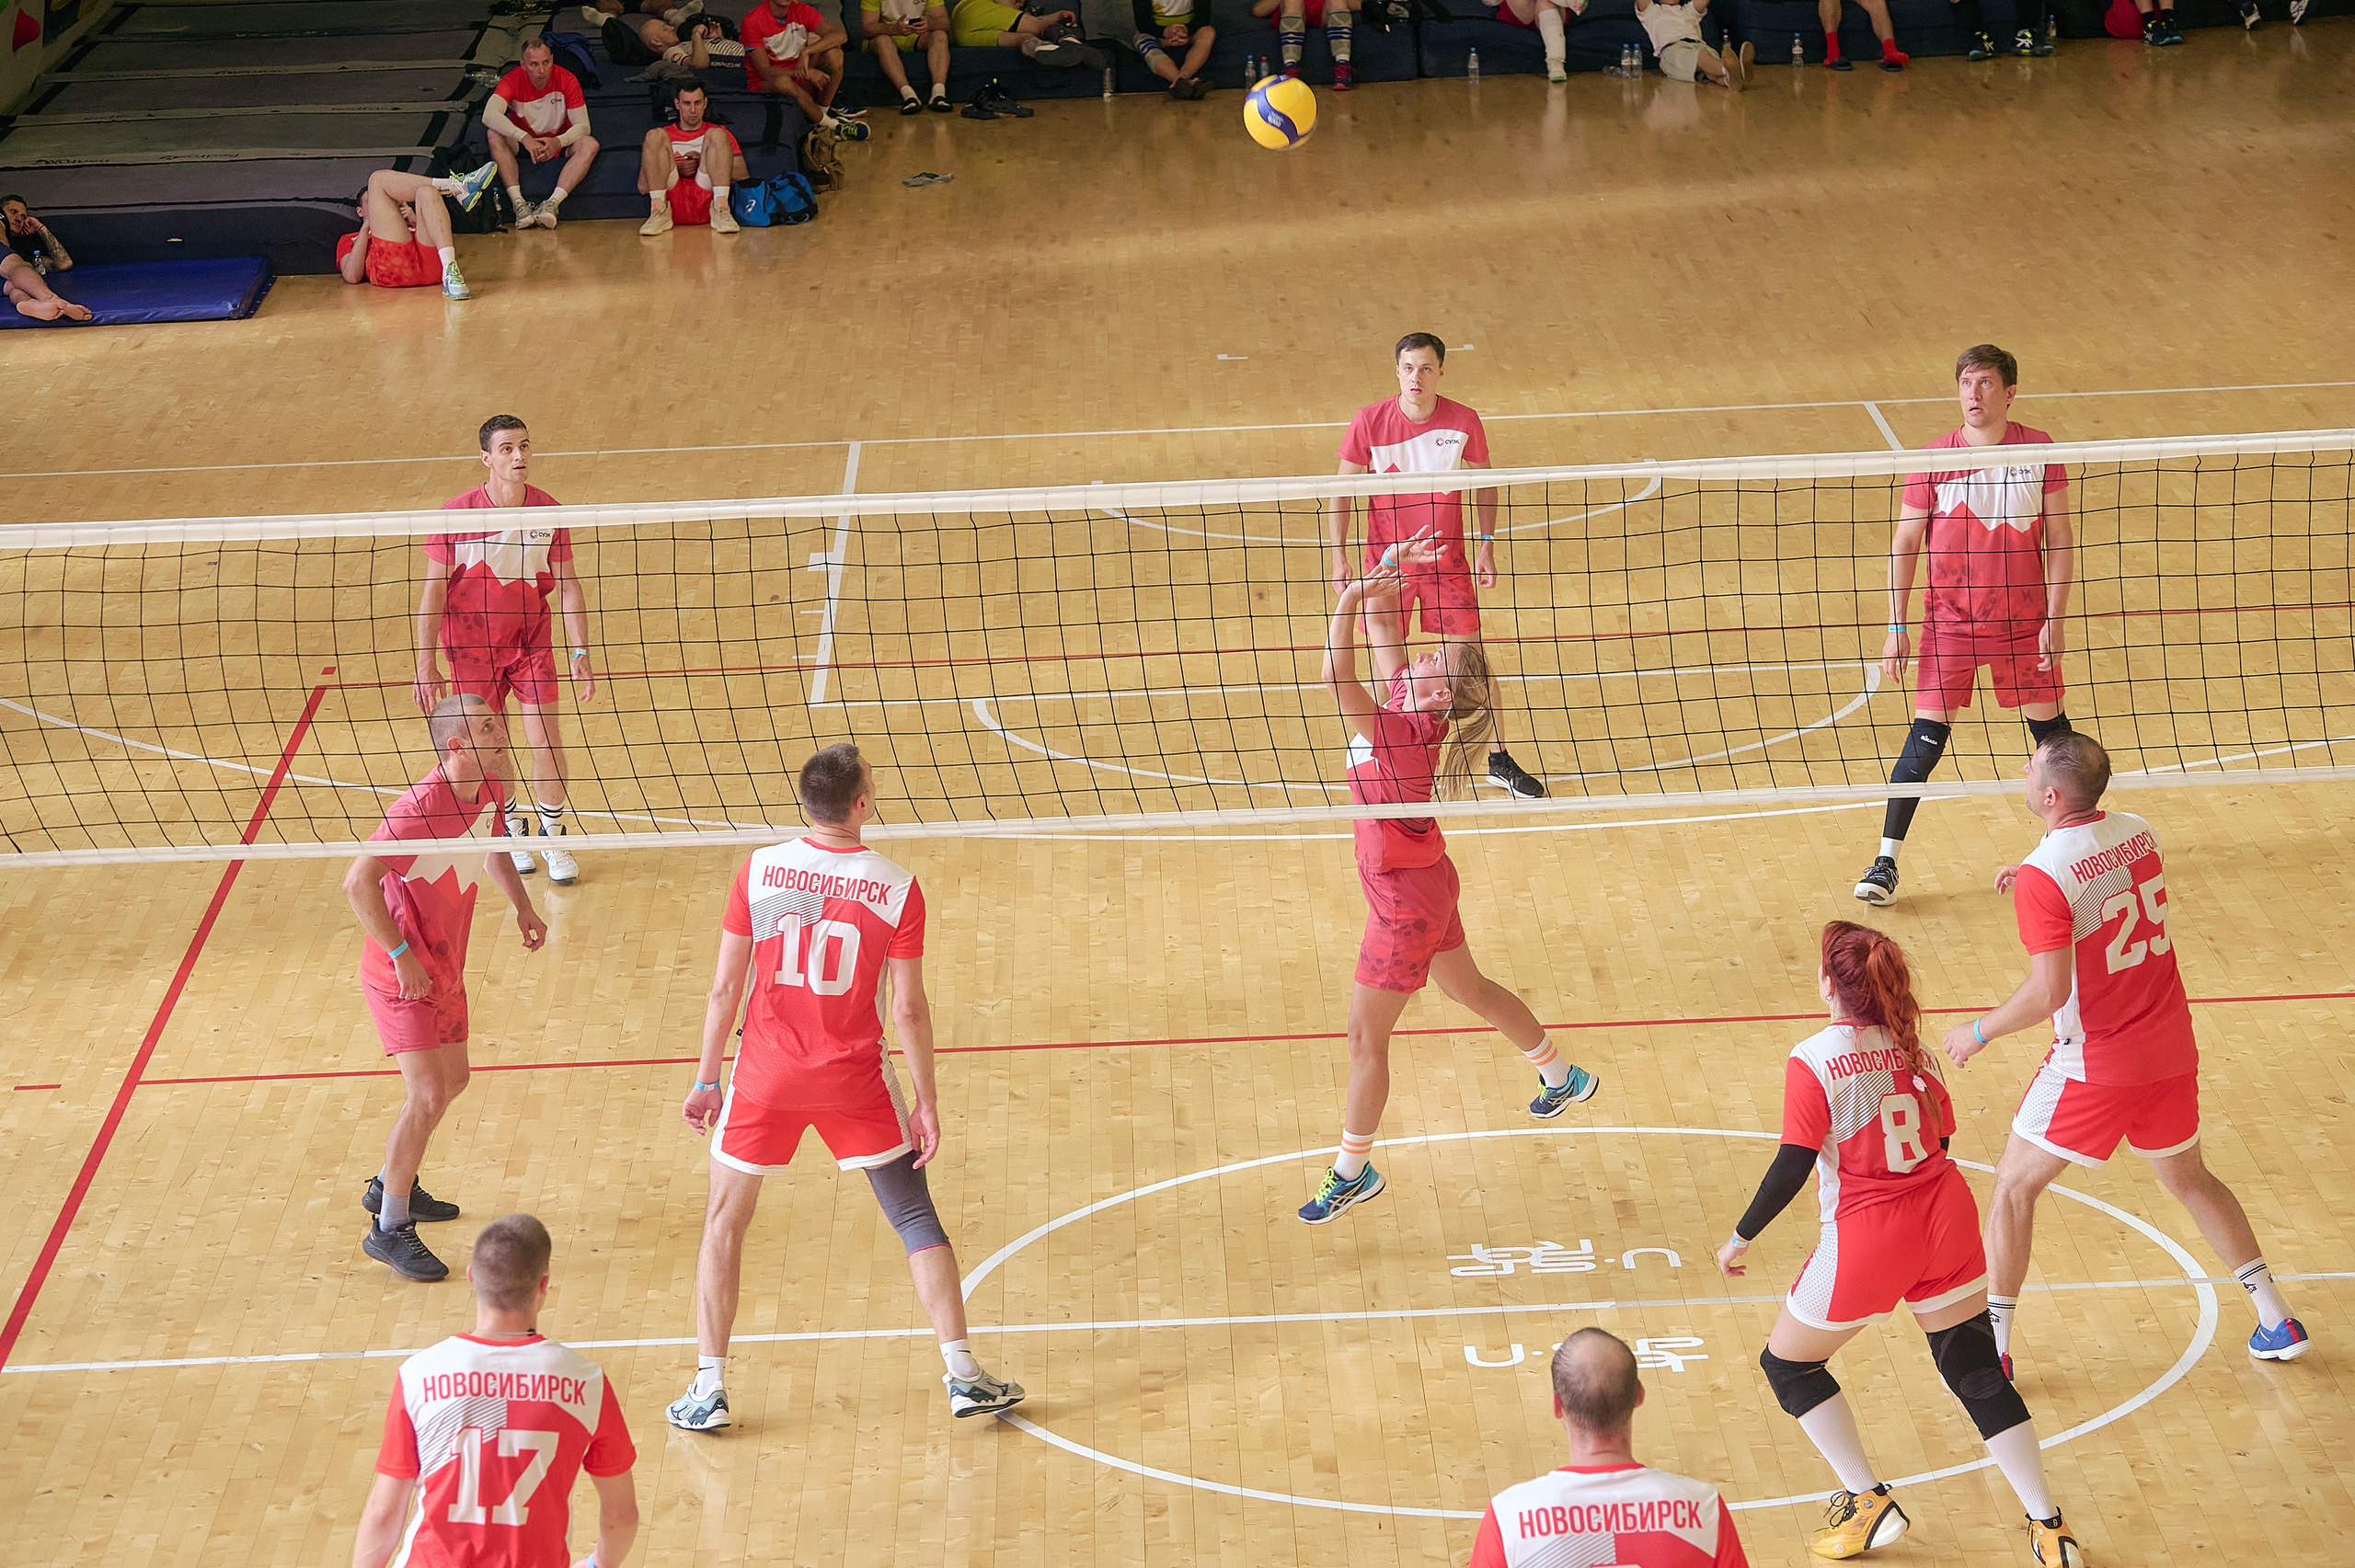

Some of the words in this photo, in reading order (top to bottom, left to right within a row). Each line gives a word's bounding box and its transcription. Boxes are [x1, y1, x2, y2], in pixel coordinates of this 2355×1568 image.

[762, 864, 892, 906] НОВОСИБИРСК
[2101, 873, 2171, 975] 25
[775, 913, 861, 996] 10
[1879, 1093, 1929, 1174] 8
[422, 1371, 587, 1406] НОВОСИБИРСК
[447, 1426, 560, 1527] 17
[1518, 1499, 1704, 1539] НОВОСИБИРСК
